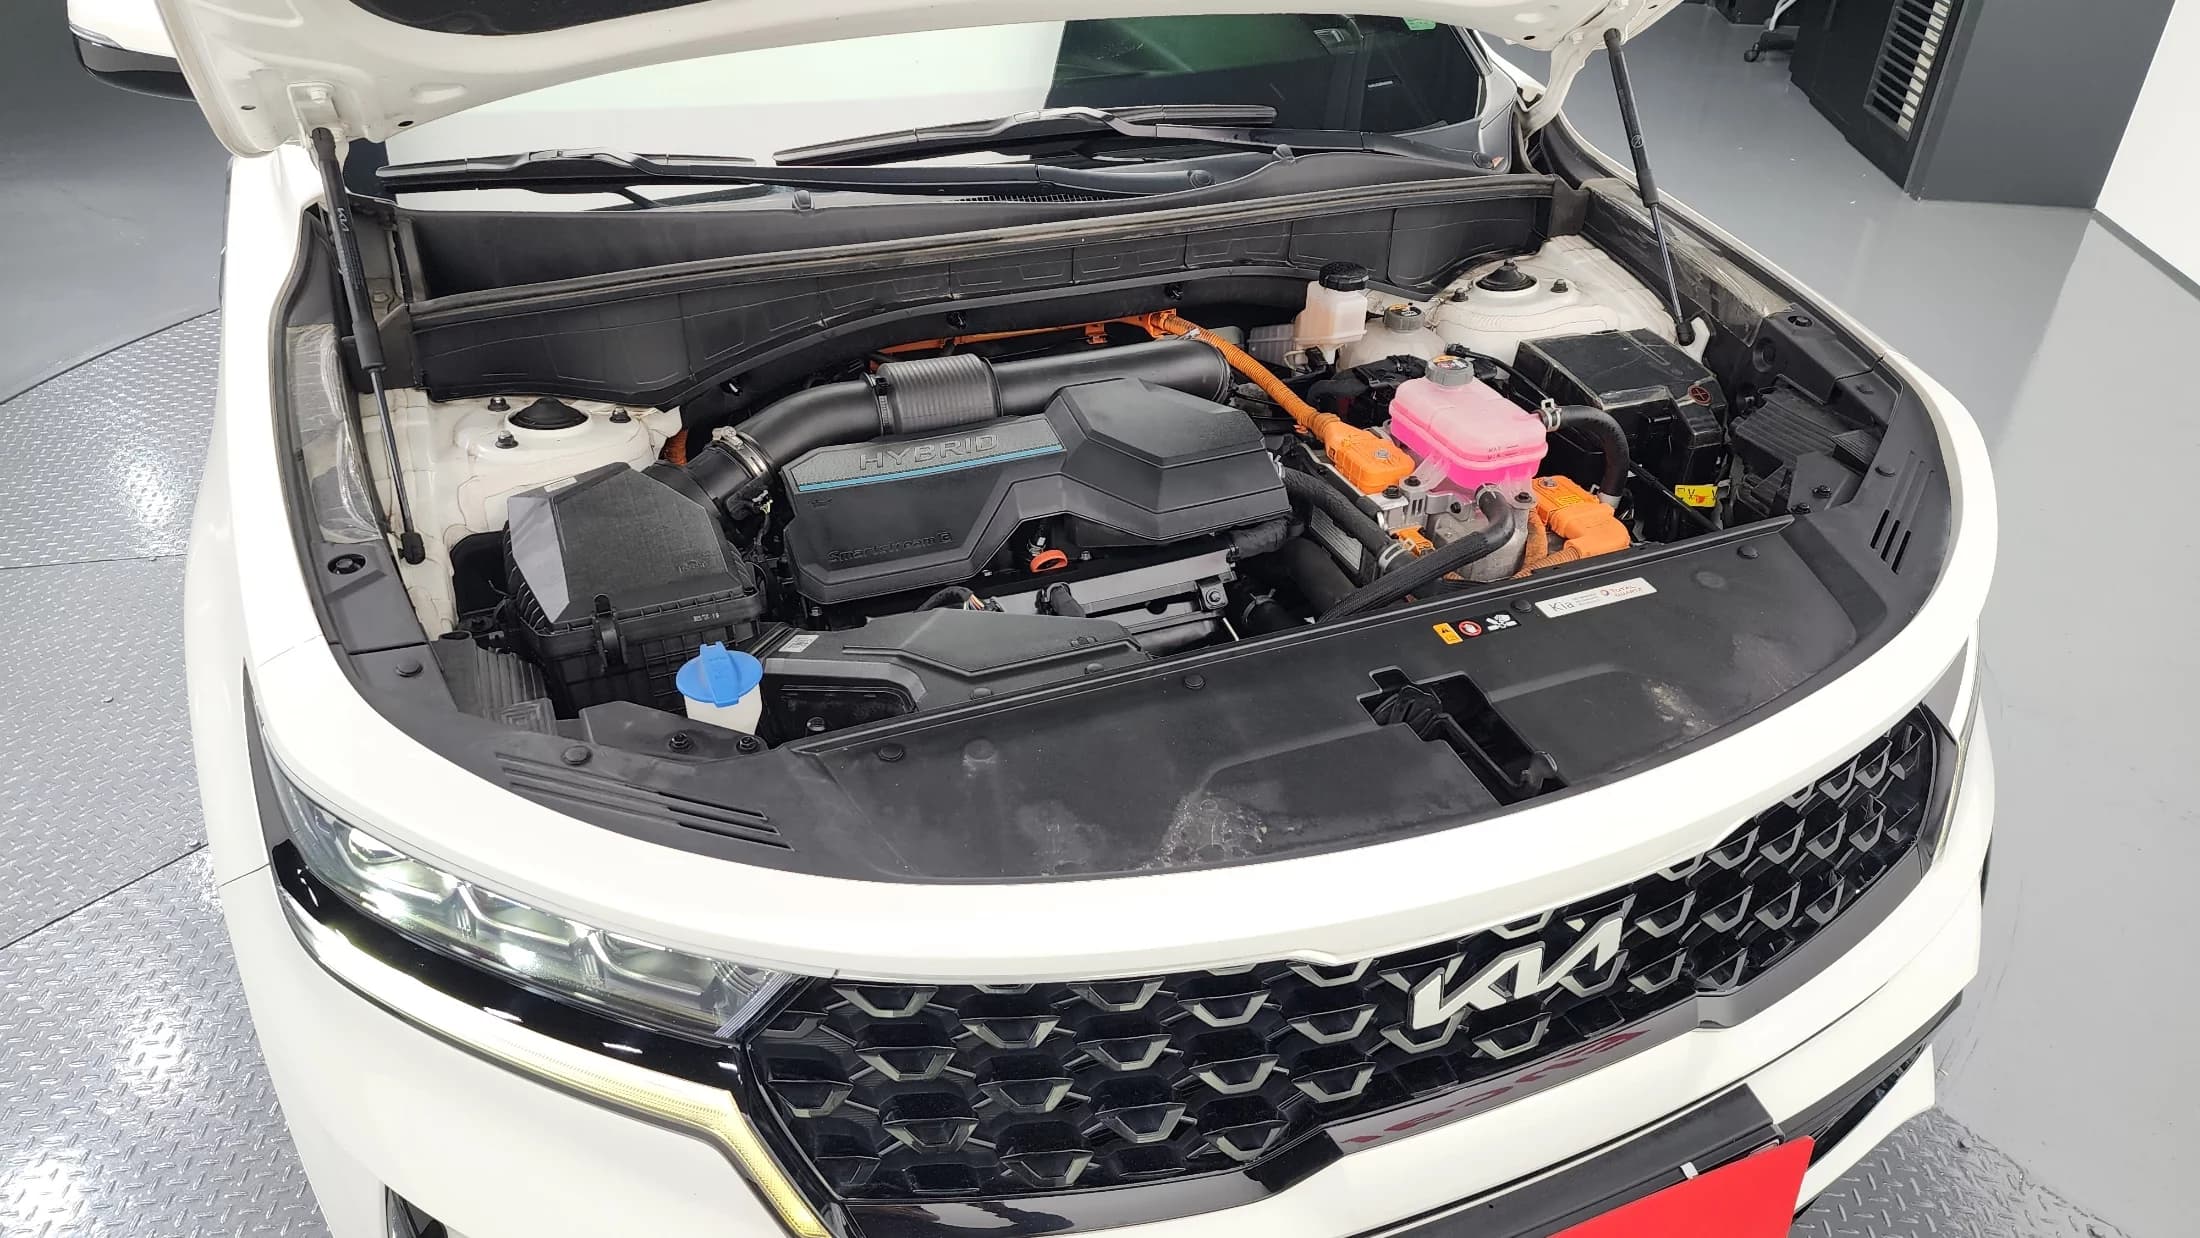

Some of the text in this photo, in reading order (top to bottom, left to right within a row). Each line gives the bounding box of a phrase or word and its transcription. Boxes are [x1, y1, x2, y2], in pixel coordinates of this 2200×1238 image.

[859, 434, 998, 470] HYBRID
[1548, 601, 1575, 612] Kia
[1410, 914, 1624, 1030] KIA
